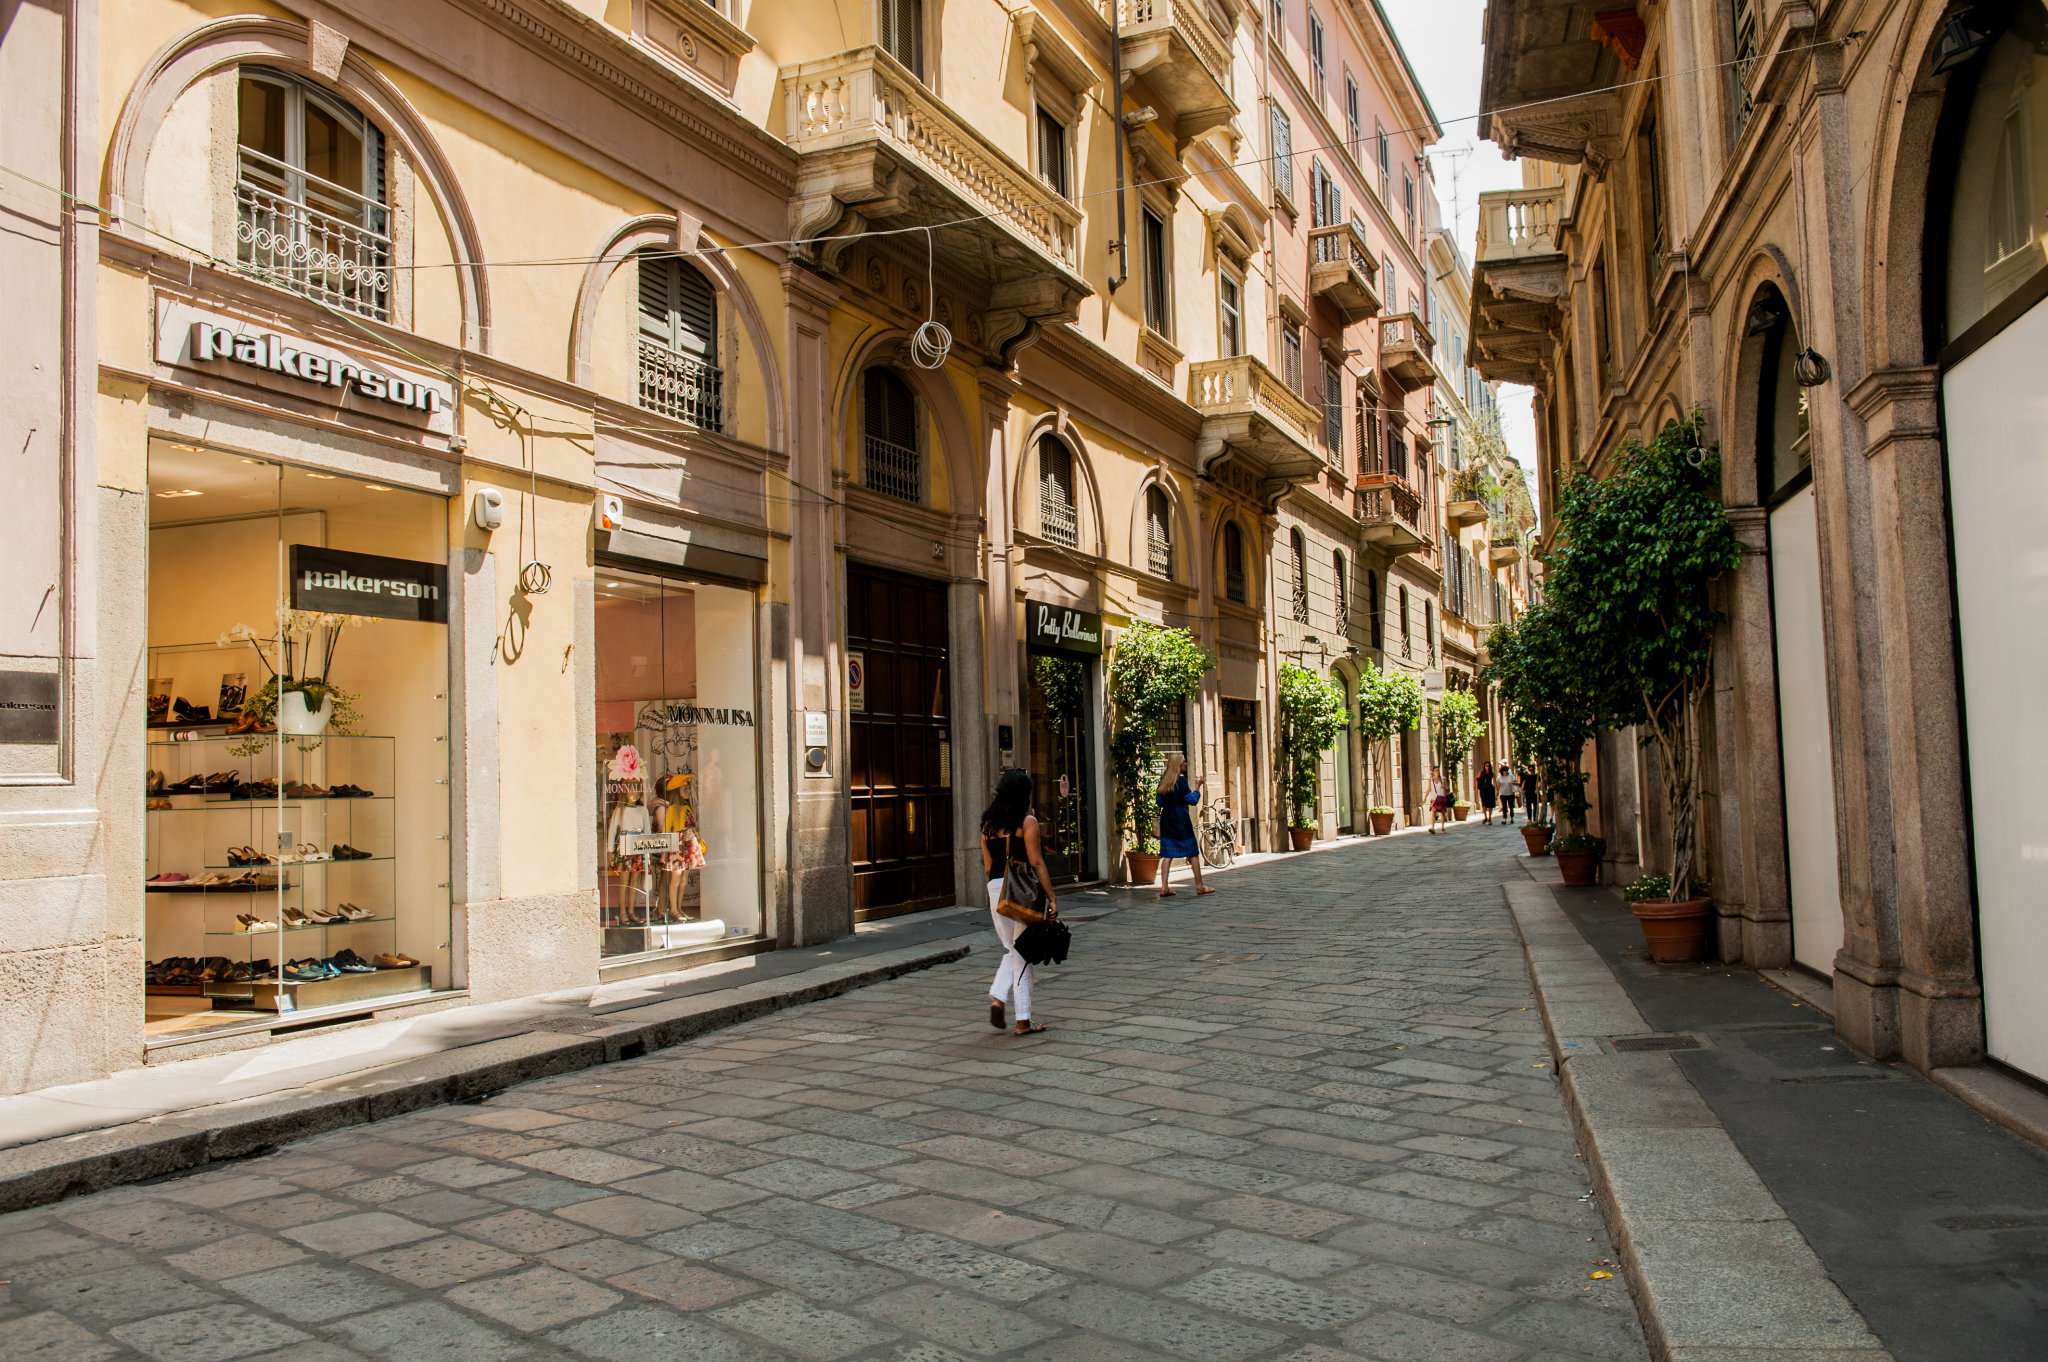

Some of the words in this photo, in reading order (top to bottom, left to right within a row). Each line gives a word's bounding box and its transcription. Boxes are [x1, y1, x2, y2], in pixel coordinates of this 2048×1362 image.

[191, 321, 441, 414] pakerson
[304, 569, 439, 600] pakerson
[1037, 605, 1060, 644] Pretty
[1062, 611, 1098, 643] Ballerinas
[665, 704, 754, 727] MONNALISA
